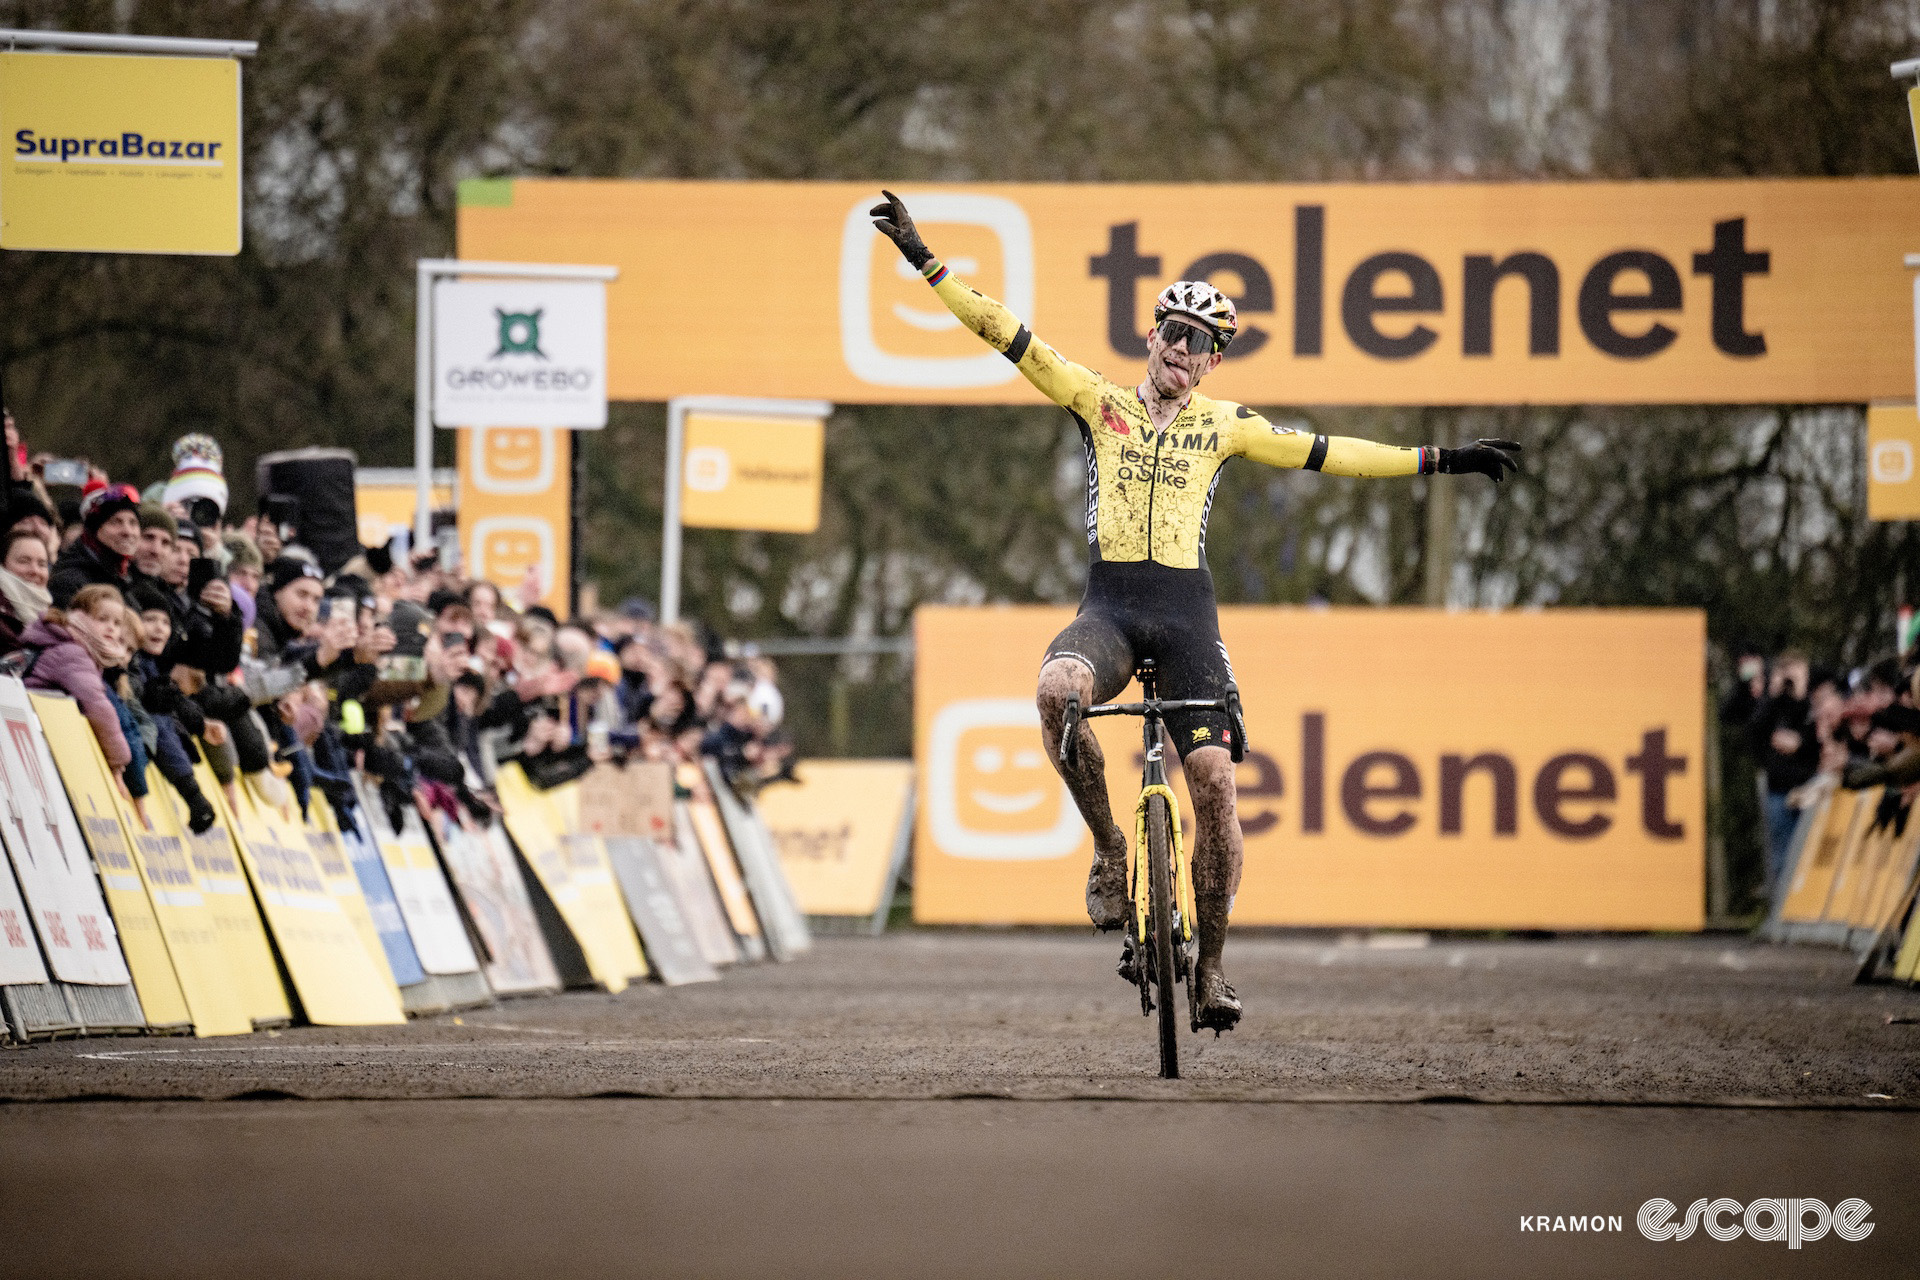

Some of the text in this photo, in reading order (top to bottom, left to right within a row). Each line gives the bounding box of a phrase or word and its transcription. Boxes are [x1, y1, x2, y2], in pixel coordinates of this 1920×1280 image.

[15, 129, 222, 162] SupraBazar
[1088, 204, 1770, 362] telenet
[447, 368, 592, 391] GROWEBO
[1120, 444, 1190, 472] lease
[1118, 464, 1187, 489] a bike
